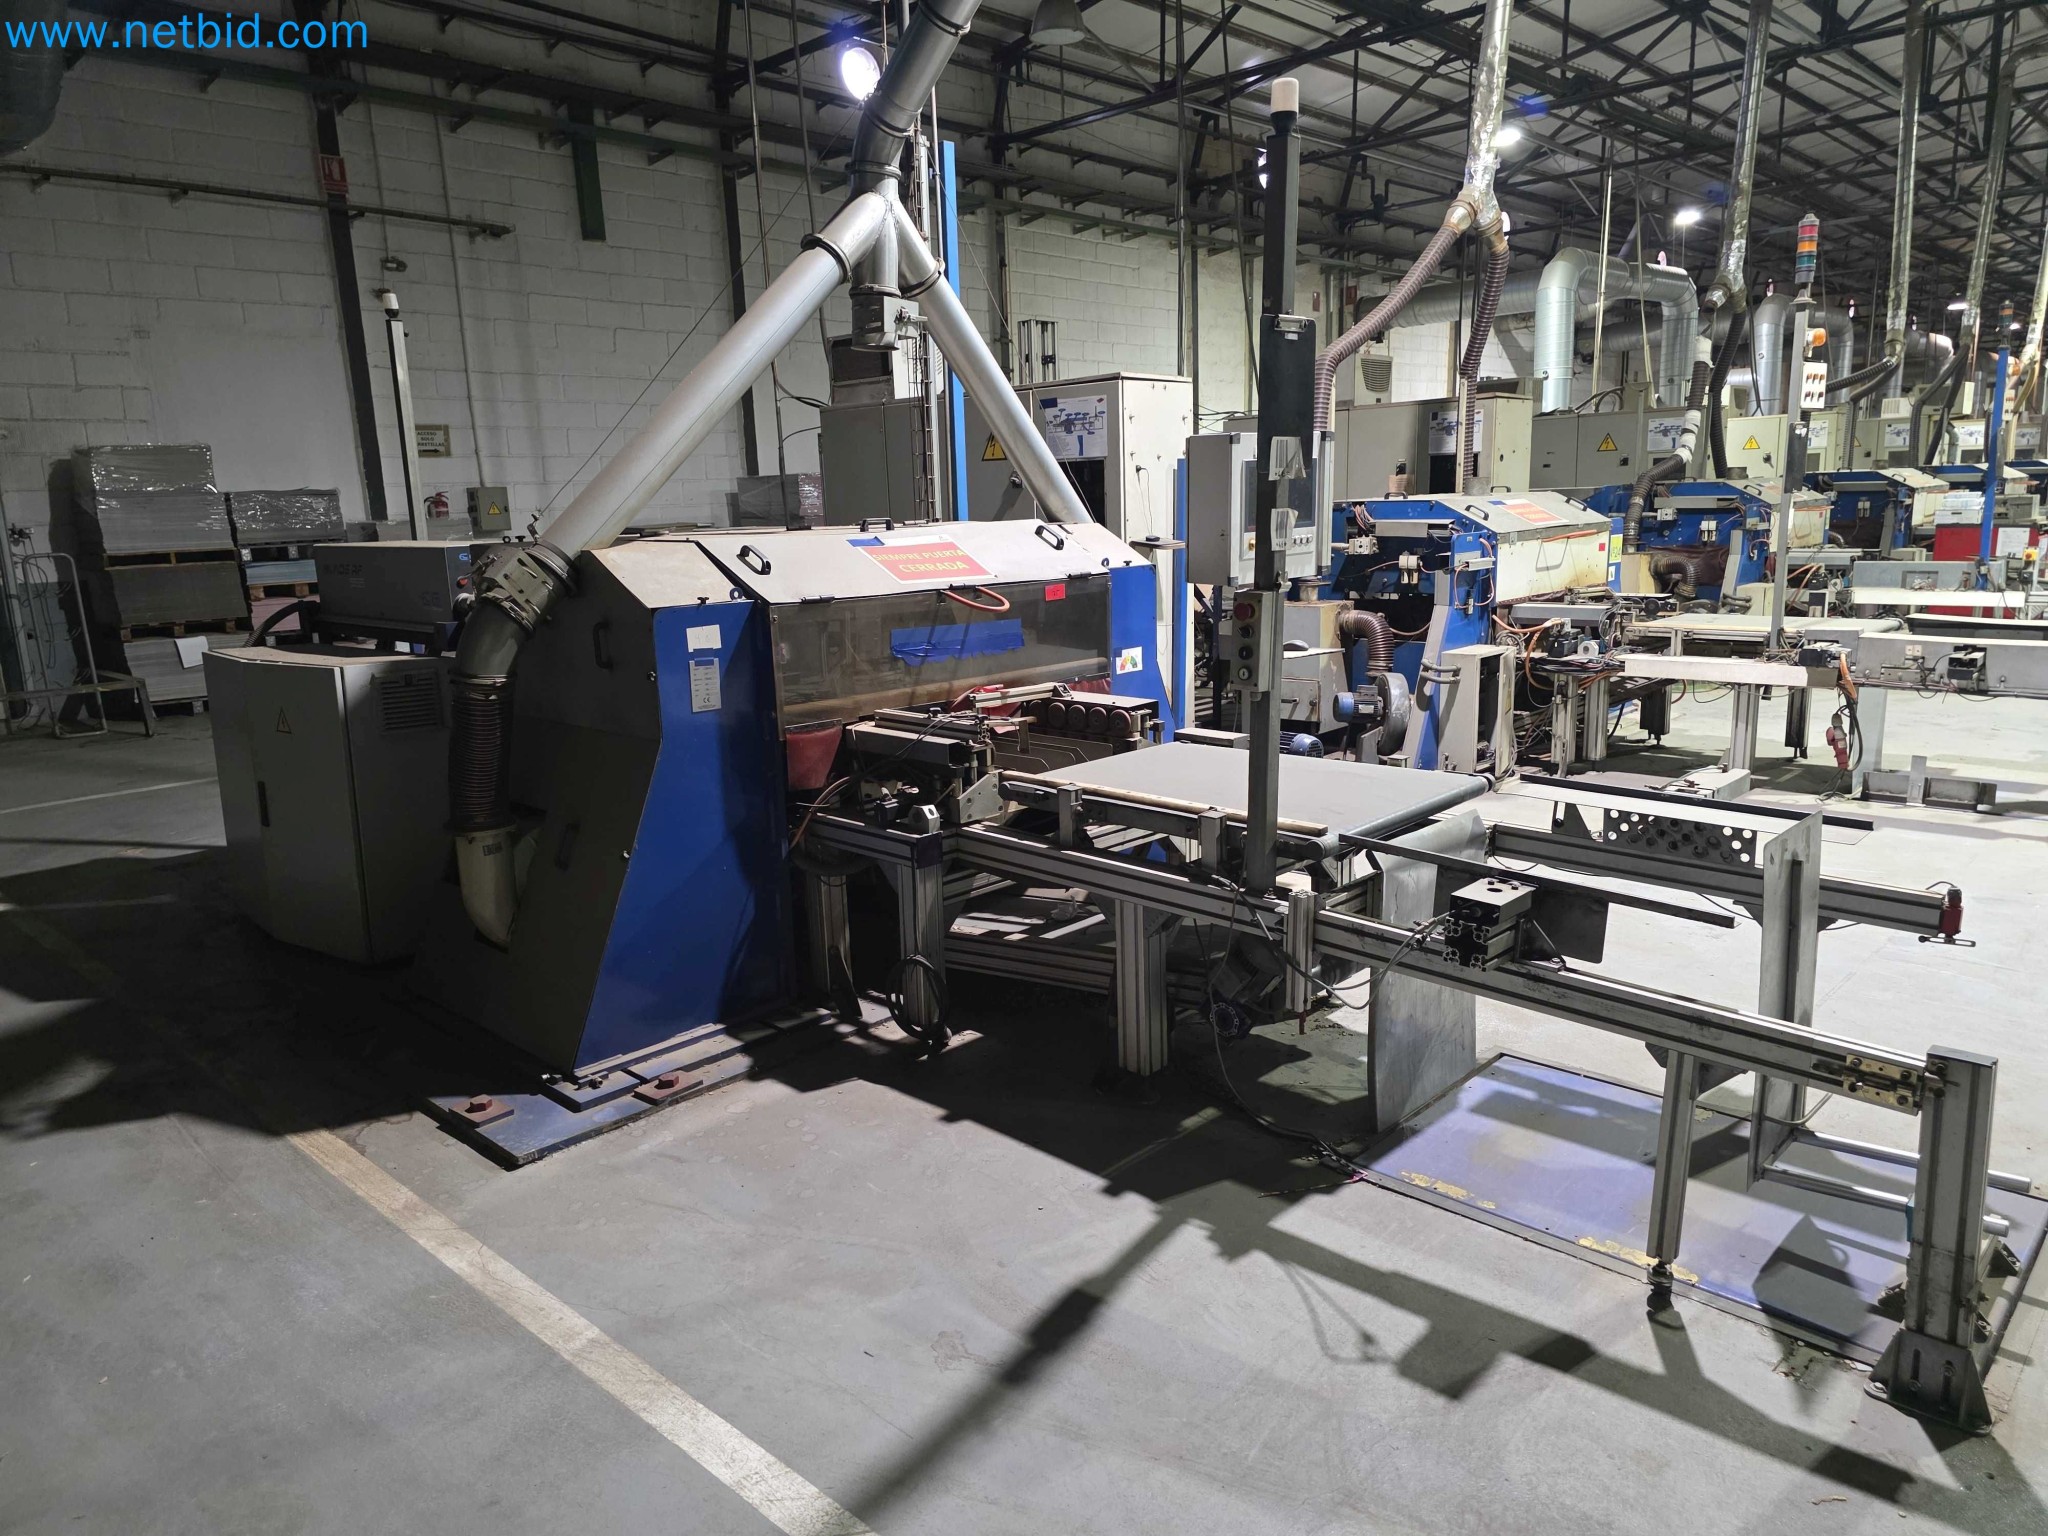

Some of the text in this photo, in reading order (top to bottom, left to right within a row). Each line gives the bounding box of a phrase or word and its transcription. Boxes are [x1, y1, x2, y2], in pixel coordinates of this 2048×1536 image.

[872, 549, 968, 561] SIEMPRE PUERTA
[900, 561, 969, 573] CERRADA
